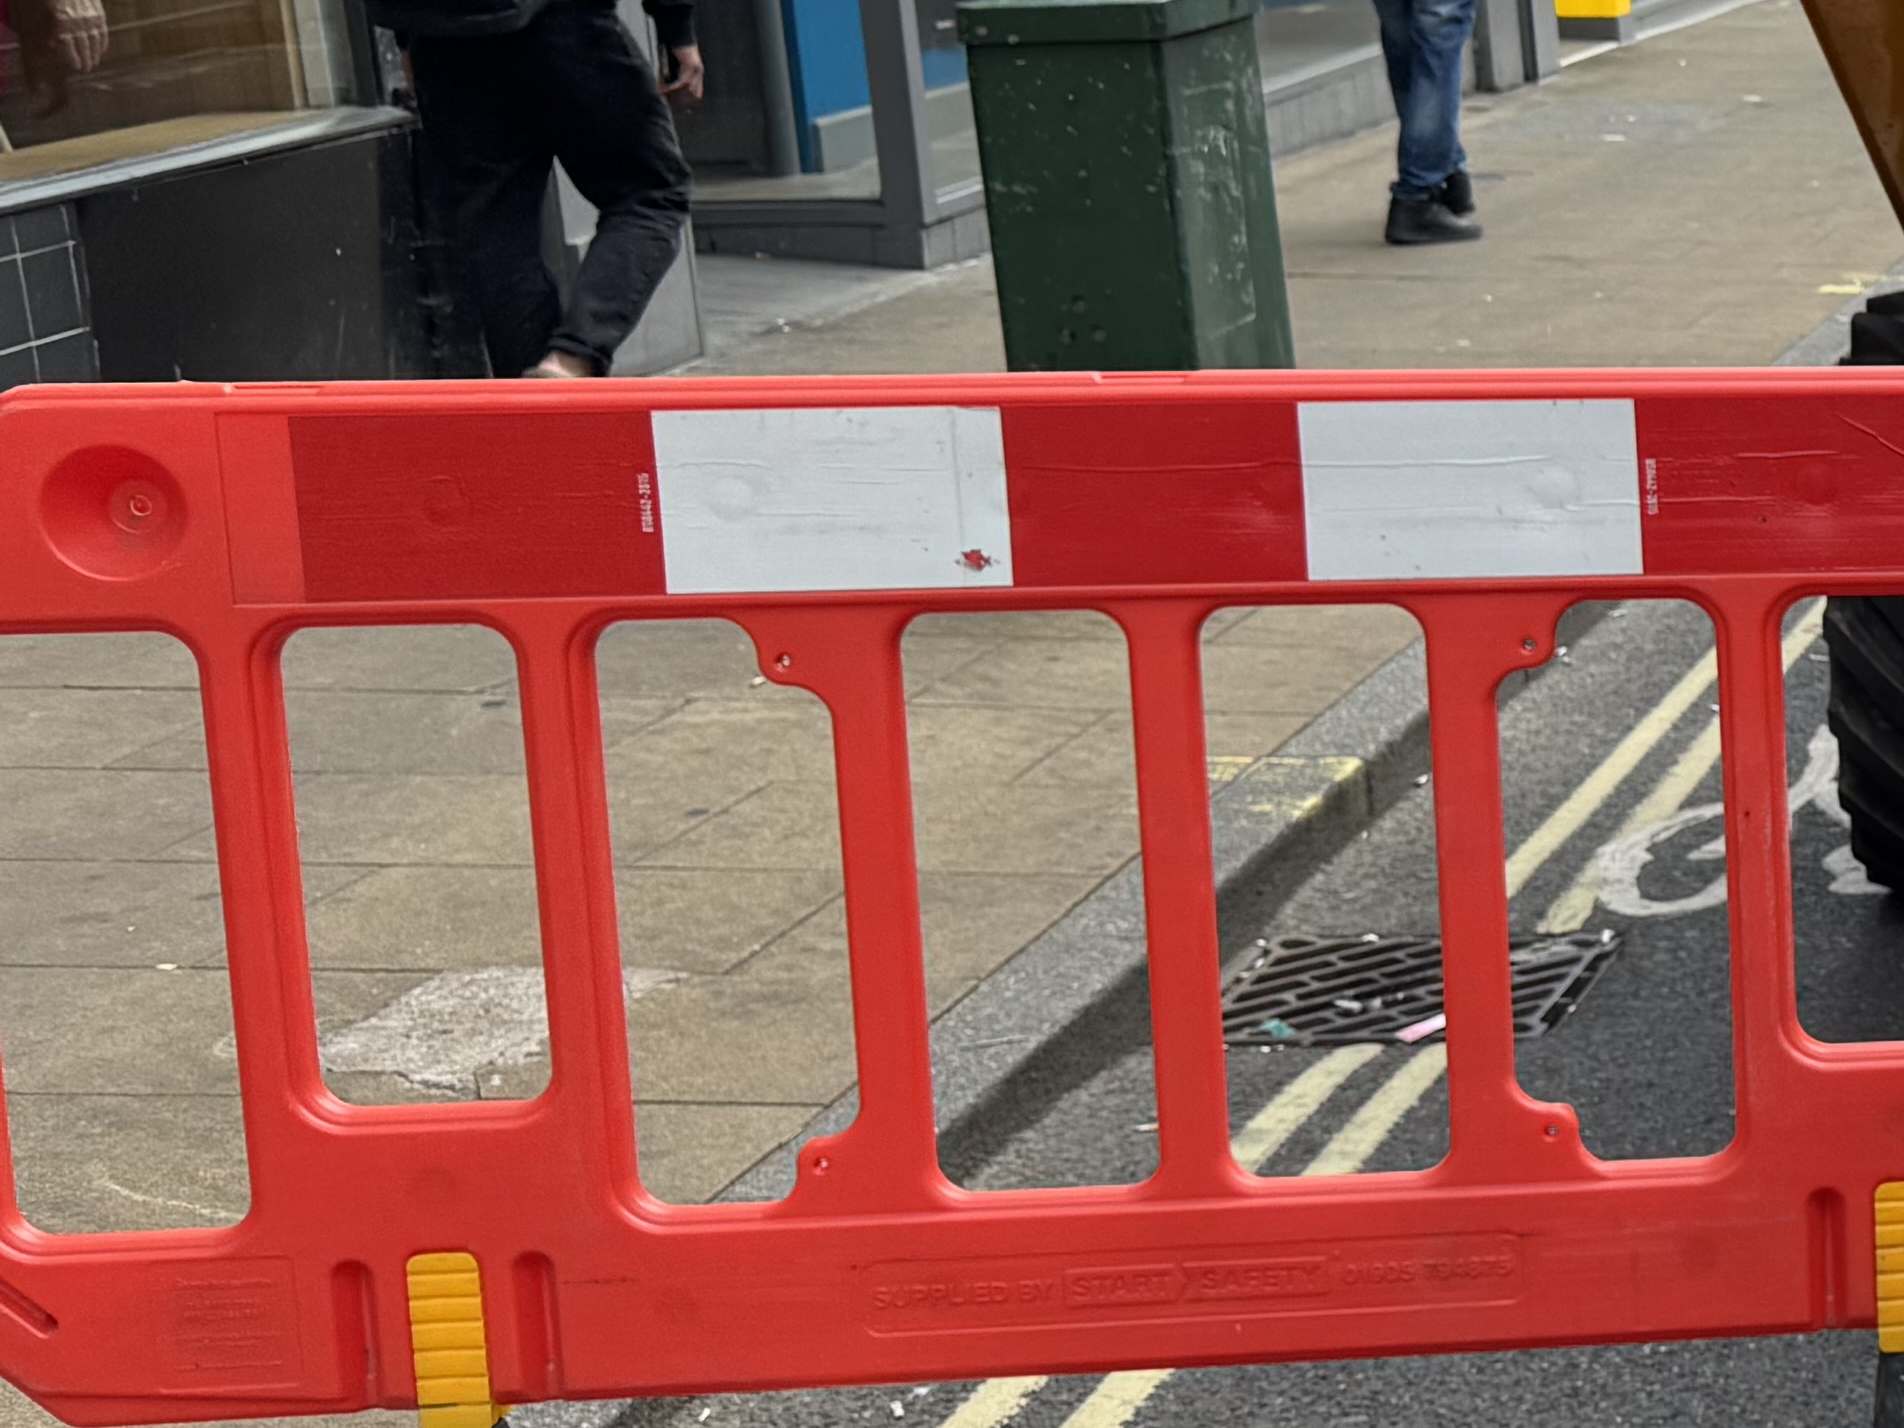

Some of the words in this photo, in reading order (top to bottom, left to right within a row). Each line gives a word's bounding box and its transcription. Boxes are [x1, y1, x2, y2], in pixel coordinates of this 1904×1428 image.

[871, 1280, 1009, 1311] SUPPLIED
[1017, 1279, 1055, 1305] BY
[1070, 1273, 1174, 1302] START
[1199, 1264, 1322, 1294] SAFETY
